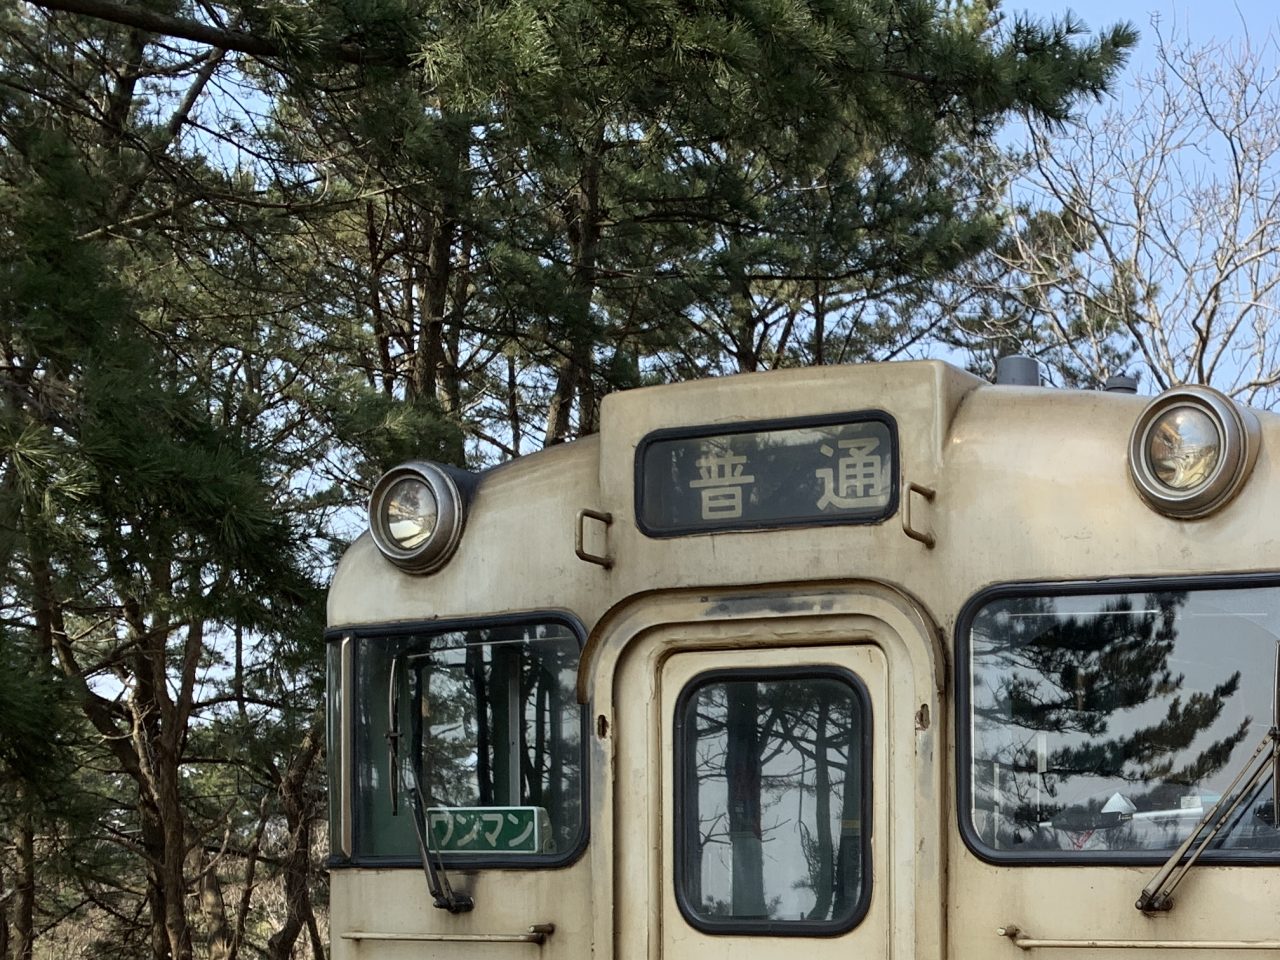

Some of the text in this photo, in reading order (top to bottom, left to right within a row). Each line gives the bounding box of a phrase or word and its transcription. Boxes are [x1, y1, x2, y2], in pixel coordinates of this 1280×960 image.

[689, 437, 886, 520] 普通
[430, 813, 534, 847] ワンマン
